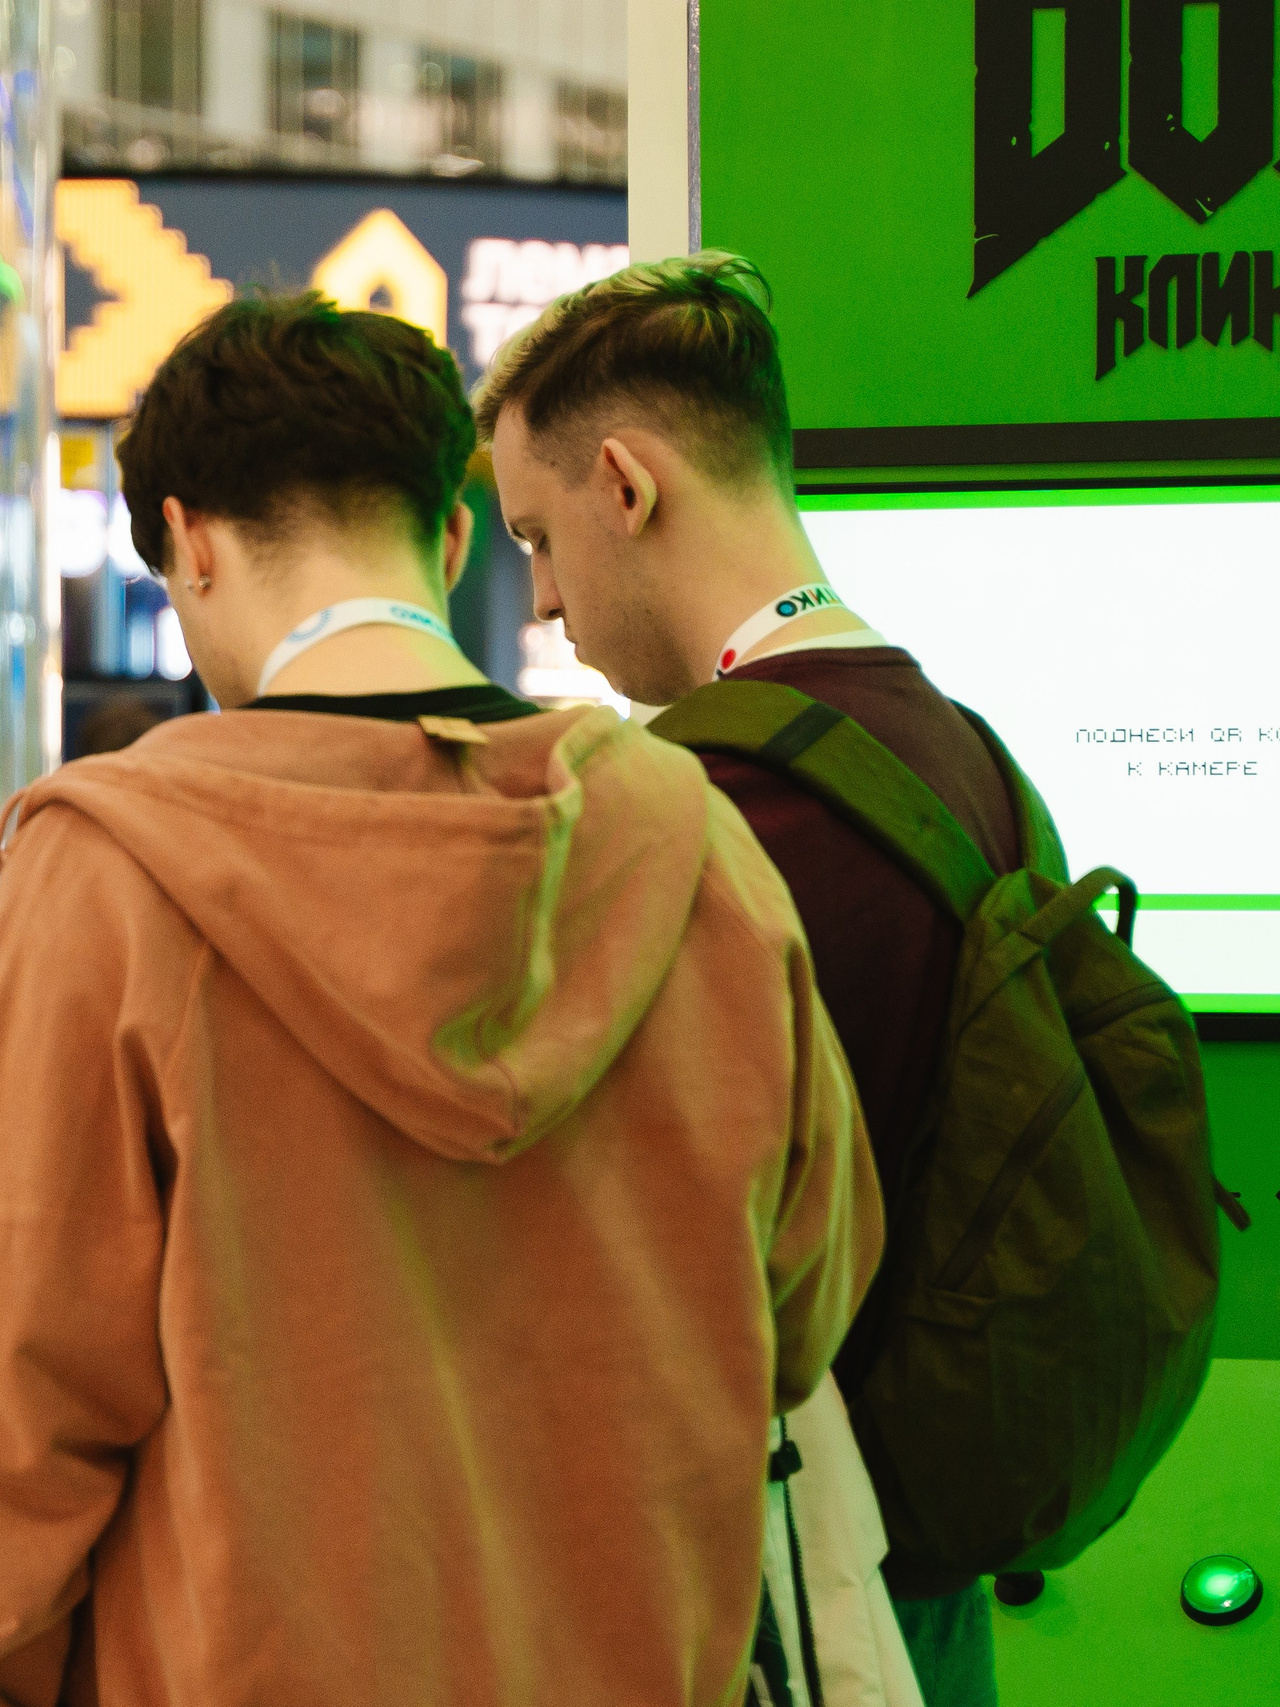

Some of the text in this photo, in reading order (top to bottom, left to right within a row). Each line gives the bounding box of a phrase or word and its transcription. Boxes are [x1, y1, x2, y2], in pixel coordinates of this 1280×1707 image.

[966, 0, 1280, 298] DO
[1076, 727, 1194, 743] ПОДНЕСИ
[1210, 727, 1242, 743] QR
[1127, 761, 1258, 776] К КАМЕРЕ
